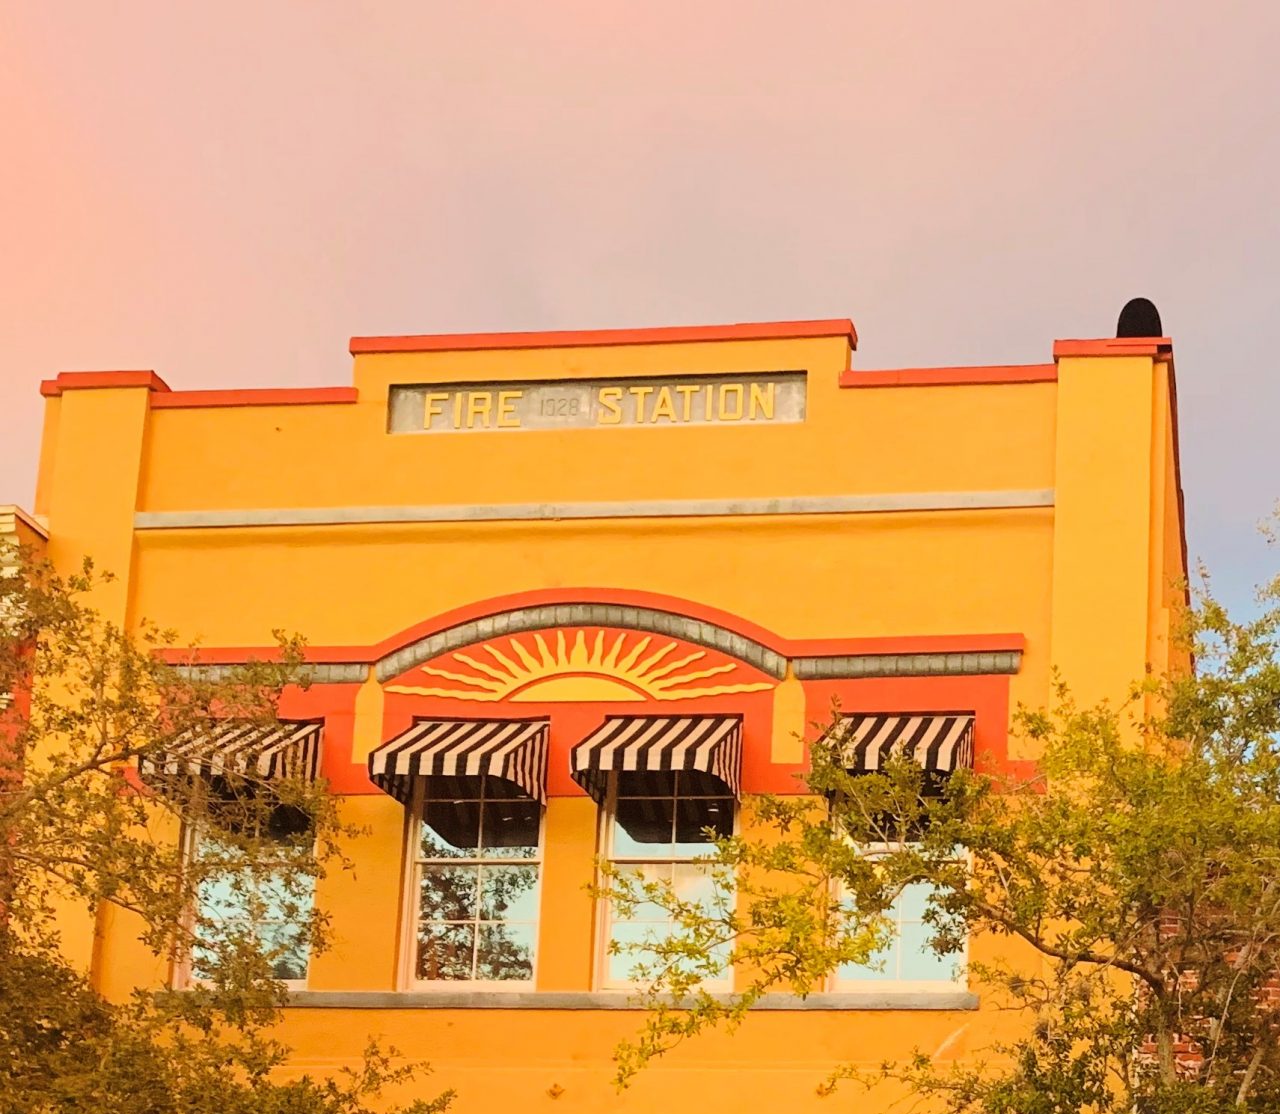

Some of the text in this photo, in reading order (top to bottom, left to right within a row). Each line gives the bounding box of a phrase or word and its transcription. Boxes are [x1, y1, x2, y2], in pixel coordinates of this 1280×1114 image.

[423, 383, 774, 429] FIRE 1928 STATION
